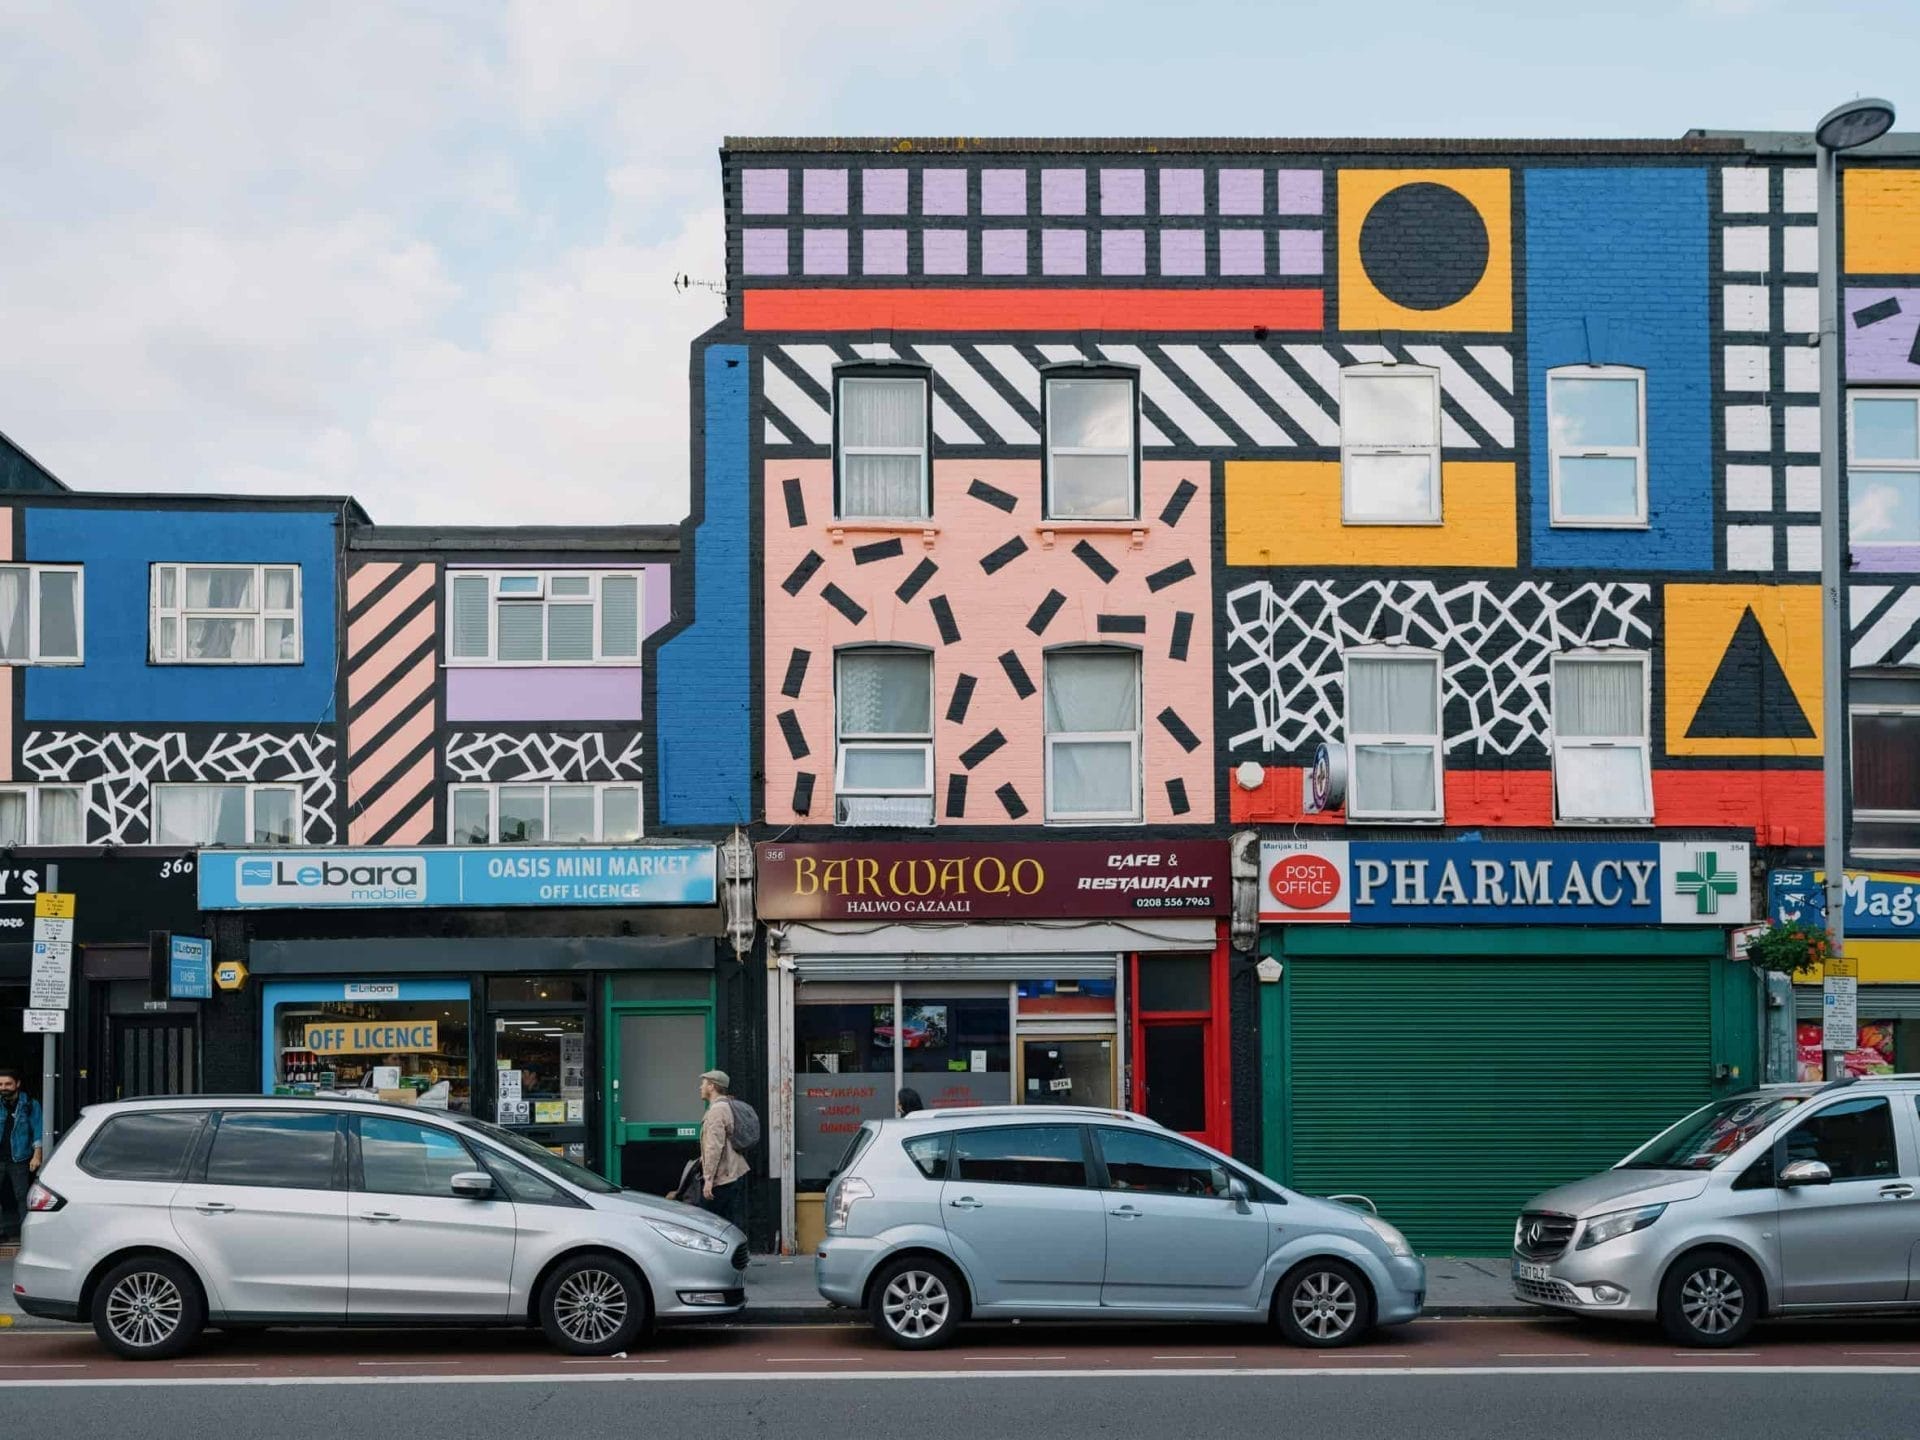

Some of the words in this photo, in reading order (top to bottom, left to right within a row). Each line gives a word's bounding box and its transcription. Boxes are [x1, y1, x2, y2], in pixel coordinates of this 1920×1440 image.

[765, 850, 784, 860] 356
[1167, 854, 1178, 866] &
[160, 859, 194, 878] 360
[277, 861, 417, 886] Lebara
[488, 858, 550, 878] OASIS
[556, 857, 602, 877] MINI
[608, 856, 689, 876] MARKET
[1286, 866, 1326, 879] POST
[793, 856, 1045, 898] BARWAQO
[1354, 859, 1657, 906] PHARMACY
[1773, 874, 1803, 886] 352
[540, 885, 569, 899] OFF
[573, 884, 640, 899] LICENCE
[1077, 876, 1212, 893] RESTAURANT
[1276, 881, 1332, 895] OFFICE
[351, 886, 417, 900] mobile
[847, 901, 901, 913] HALWO
[904, 900, 971, 912] GAZAALI
[1136, 898, 1162, 908] 0208
[1164, 898, 1183, 907] 556
[1185, 897, 1211, 906] 7963
[1841, 875, 1920, 926] Mag
[221, 971, 236, 980] ADT
[358, 983, 394, 993] Lebara
[308, 1029, 345, 1050] OFF
[353, 1026, 433, 1049] LICENCE
